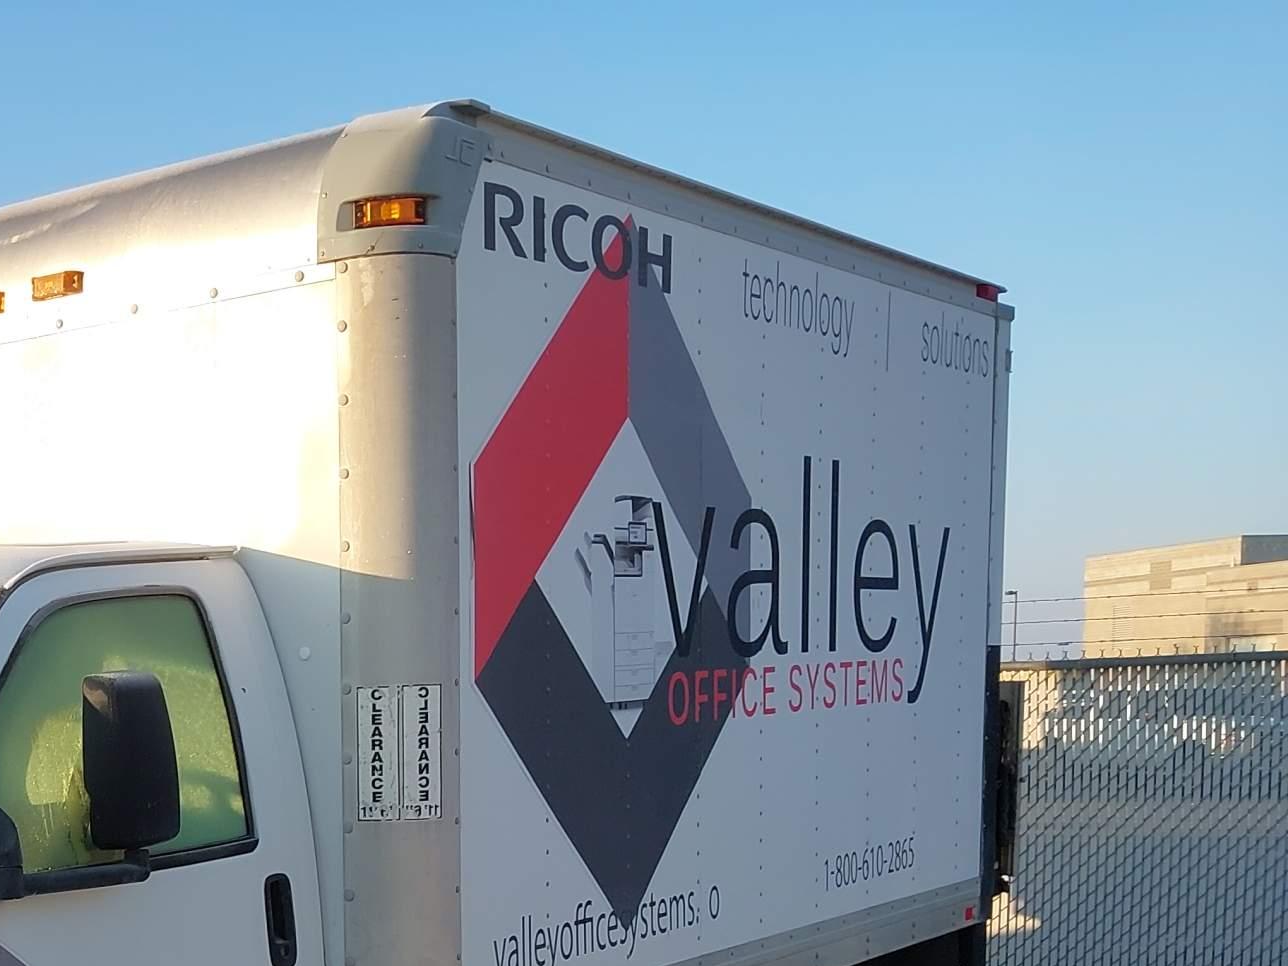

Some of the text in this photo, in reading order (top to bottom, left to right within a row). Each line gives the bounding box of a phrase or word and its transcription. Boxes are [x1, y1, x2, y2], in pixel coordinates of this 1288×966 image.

[483, 181, 672, 295] RICOH
[742, 258, 990, 378] technology solutions
[651, 456, 950, 704] valley
[371, 689, 384, 803] CLEARANCE
[668, 658, 904, 726] OFFICE SYSTEMS
[824, 837, 915, 891] 1-800-610-2865
